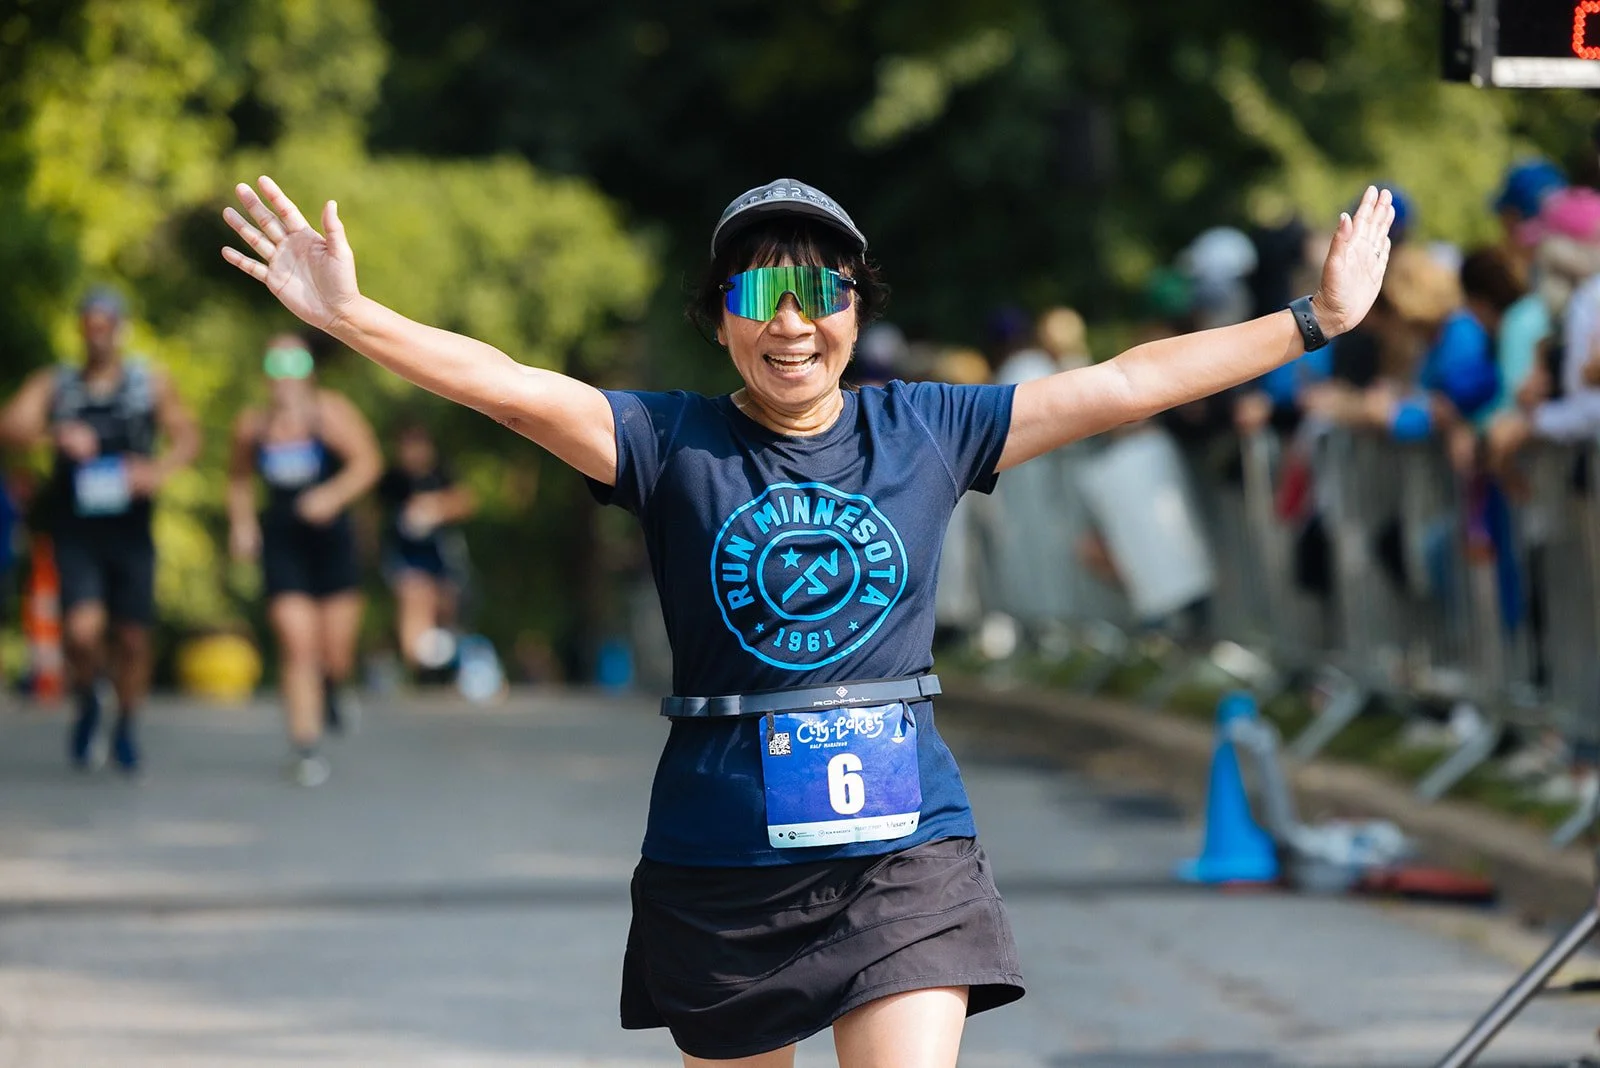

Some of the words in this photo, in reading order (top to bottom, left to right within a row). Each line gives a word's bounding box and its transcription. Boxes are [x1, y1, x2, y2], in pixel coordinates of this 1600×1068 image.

[722, 534, 757, 610] RUN
[752, 495, 897, 607] MINNESOTA
[773, 627, 836, 653] 1961
[797, 716, 829, 743] City
[827, 753, 866, 815] 6
